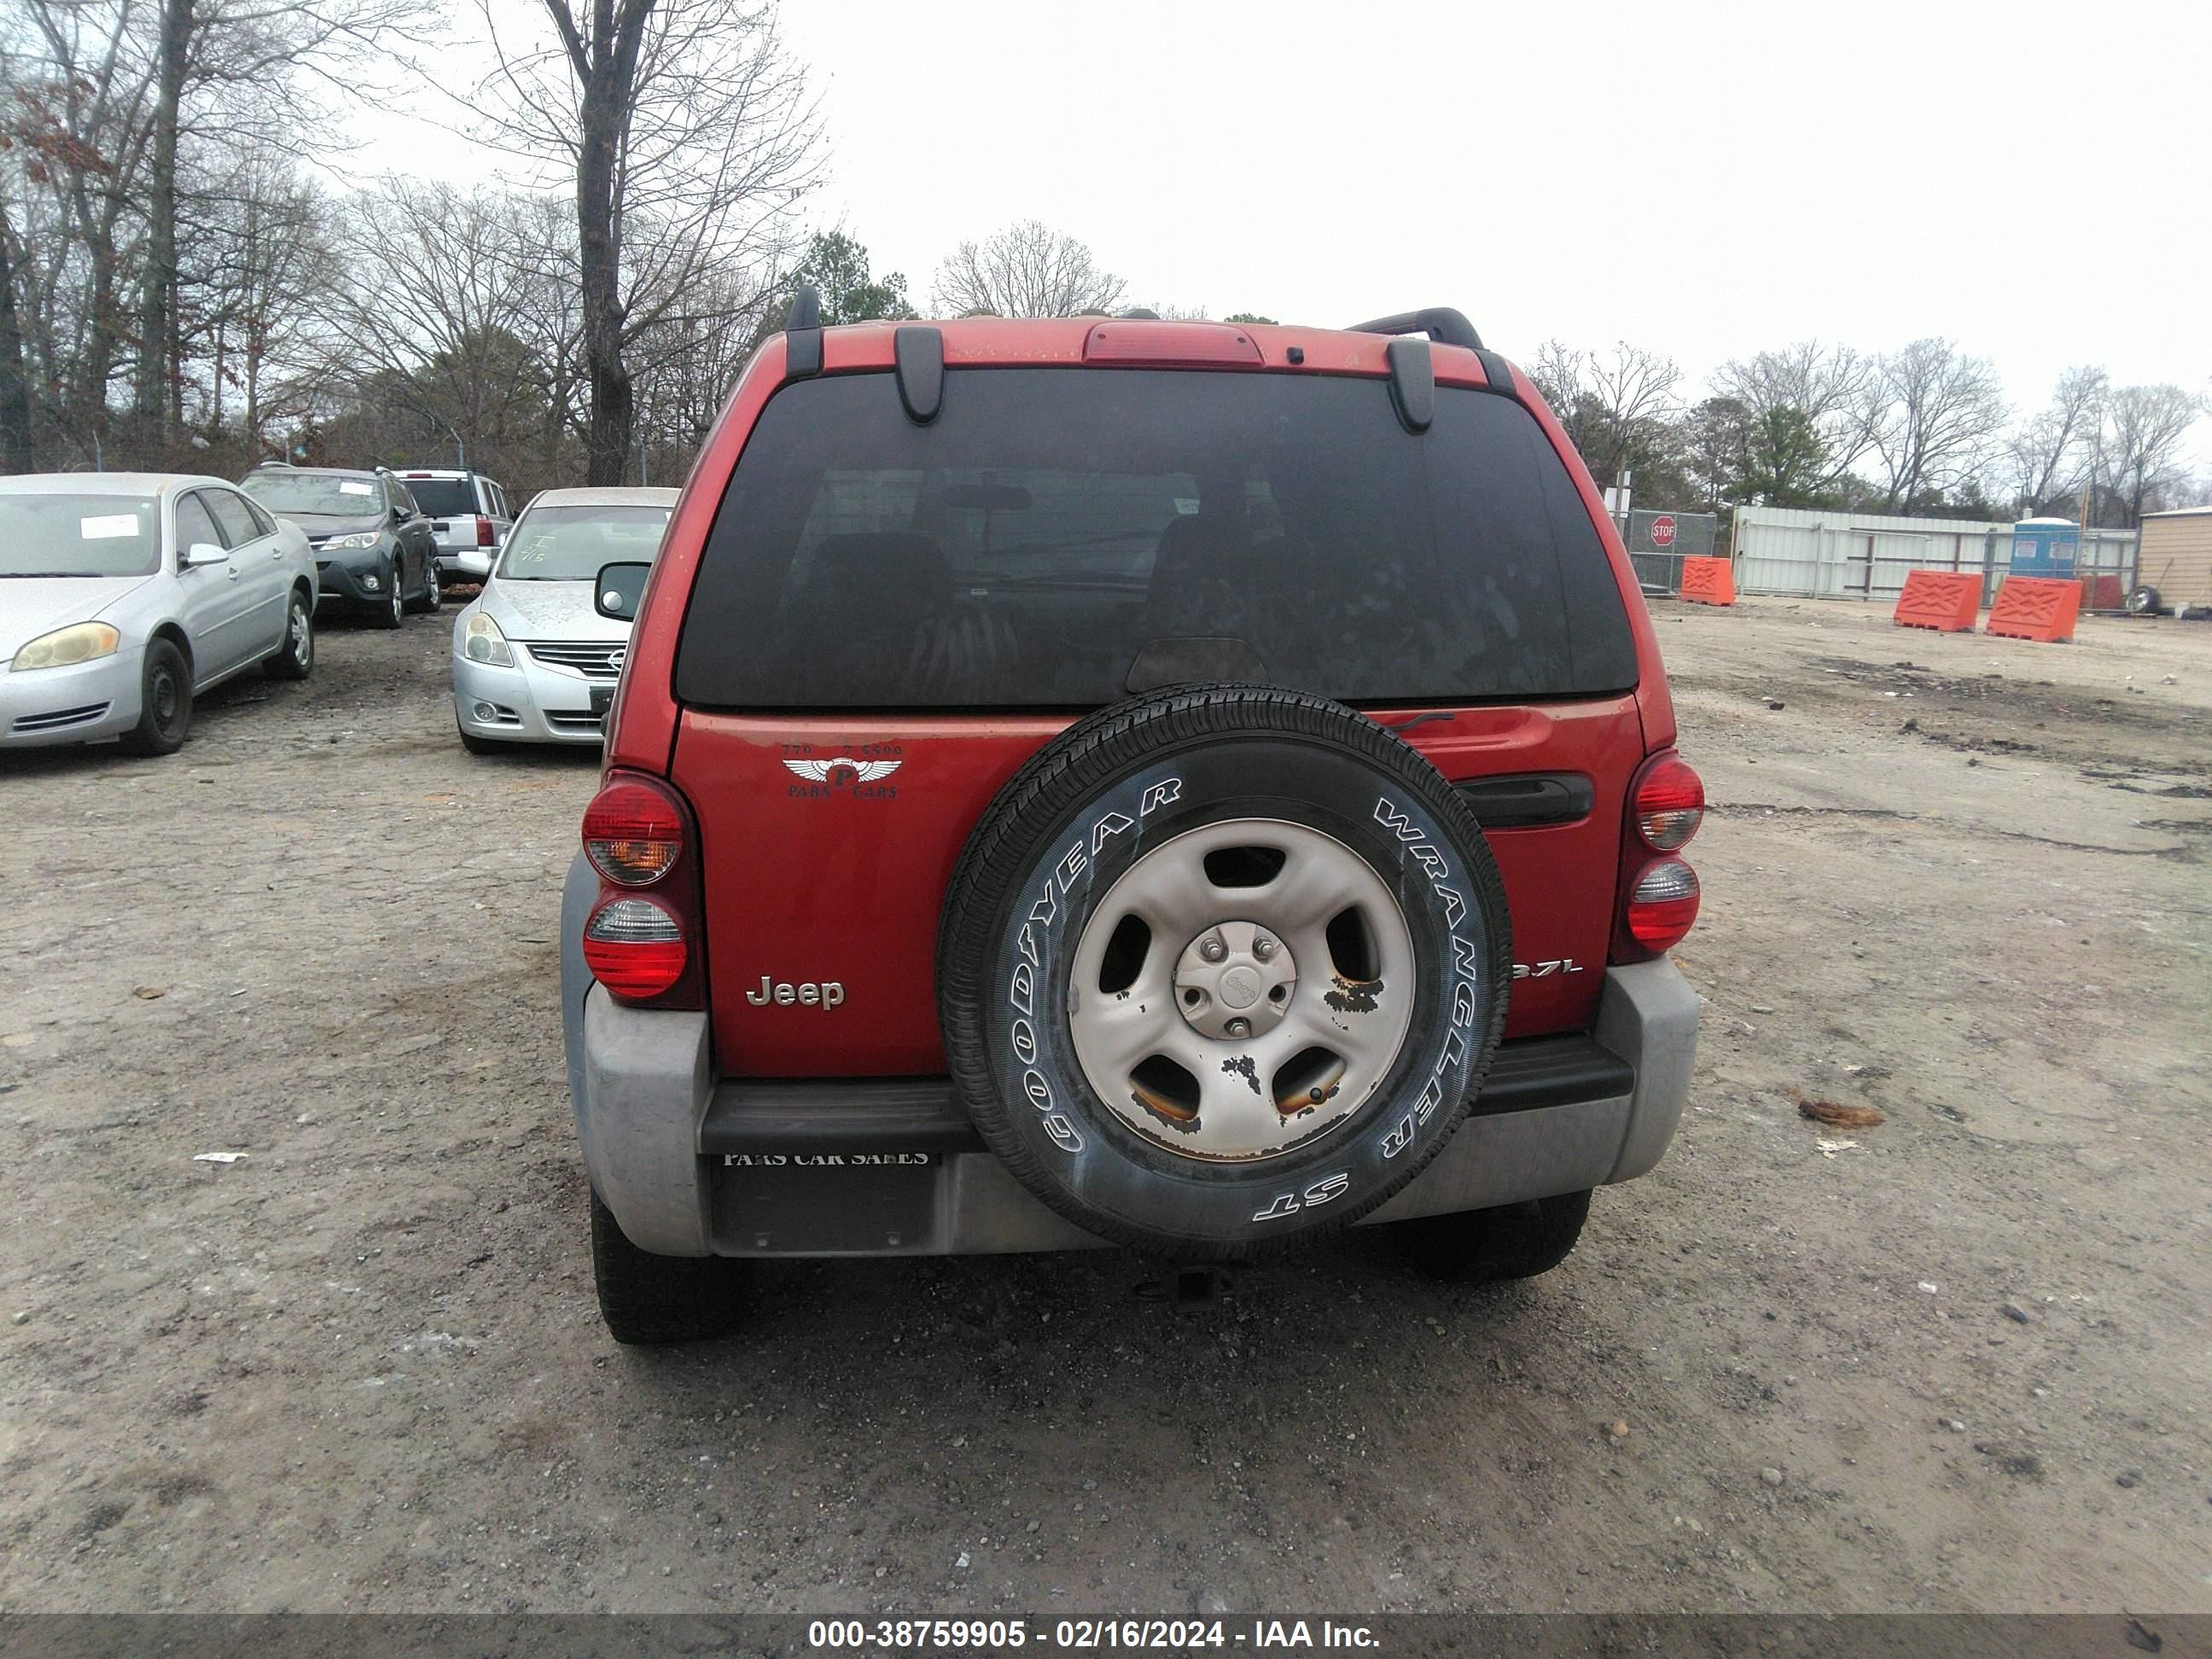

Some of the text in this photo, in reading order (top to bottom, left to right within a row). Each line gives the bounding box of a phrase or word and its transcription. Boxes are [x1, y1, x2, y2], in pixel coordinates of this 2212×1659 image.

[1653, 525, 1674, 537] STOP
[746, 975, 845, 1011] Jeep
[1010, 777, 1183, 1154] GOODYEAR
[1252, 798, 1476, 1222] WRANGLER ST
